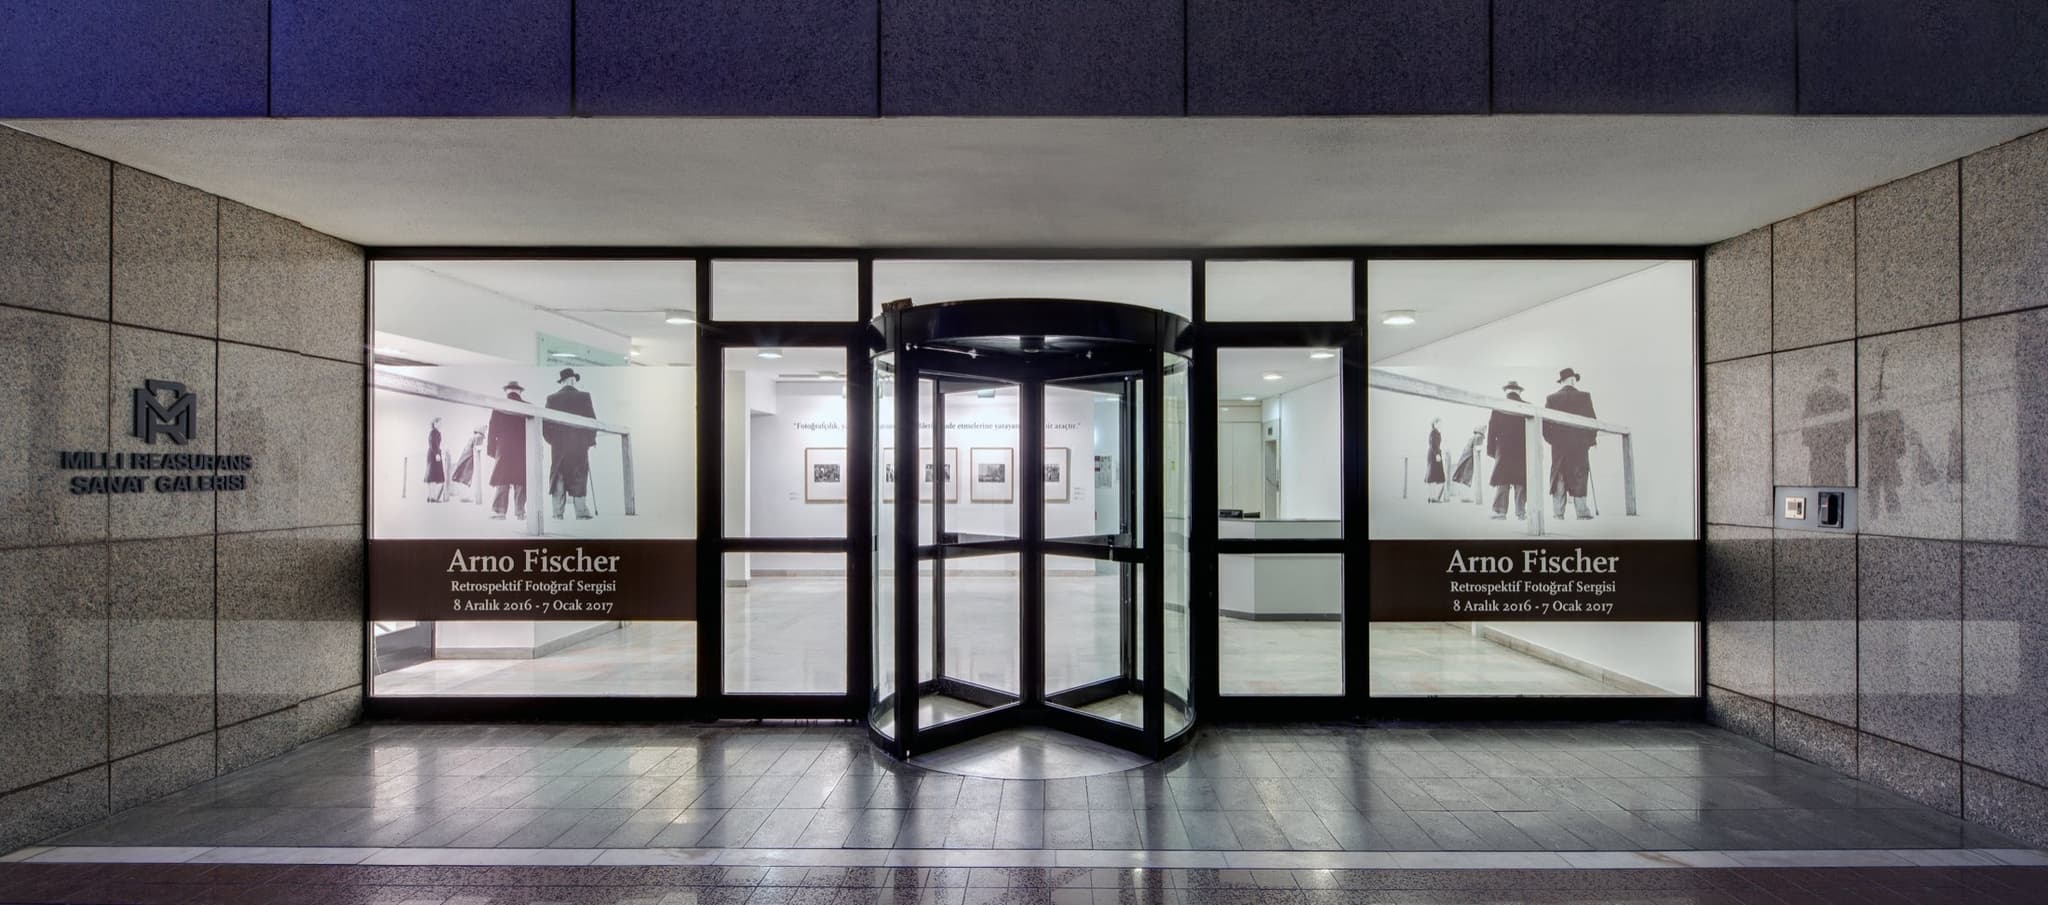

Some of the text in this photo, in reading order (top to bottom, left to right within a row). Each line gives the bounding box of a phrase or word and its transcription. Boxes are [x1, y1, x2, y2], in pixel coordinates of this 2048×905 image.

[70, 476, 149, 495] SANAT
[447, 547, 620, 572] Arno Fischer
[1446, 548, 1619, 573] Arno Fischer
[451, 580, 615, 594] Retrospektif Fotoğraf Sergisi
[1451, 580, 1615, 595] Retrospektif Fotoğraf Sergisi
[454, 599, 461, 610] 8
[465, 599, 499, 611] Aralık
[504, 599, 532, 610] 2016
[543, 603, 549, 614] 7
[553, 599, 582, 610] Ocak
[586, 603, 613, 613] 2017
[1453, 600, 1460, 611] 8
[1464, 600, 1499, 611] Aralık
[1503, 600, 1531, 611] 2016
[1542, 603, 1549, 614] 7
[1553, 600, 1582, 611] Ocak
[1586, 603, 1613, 614] 2017
